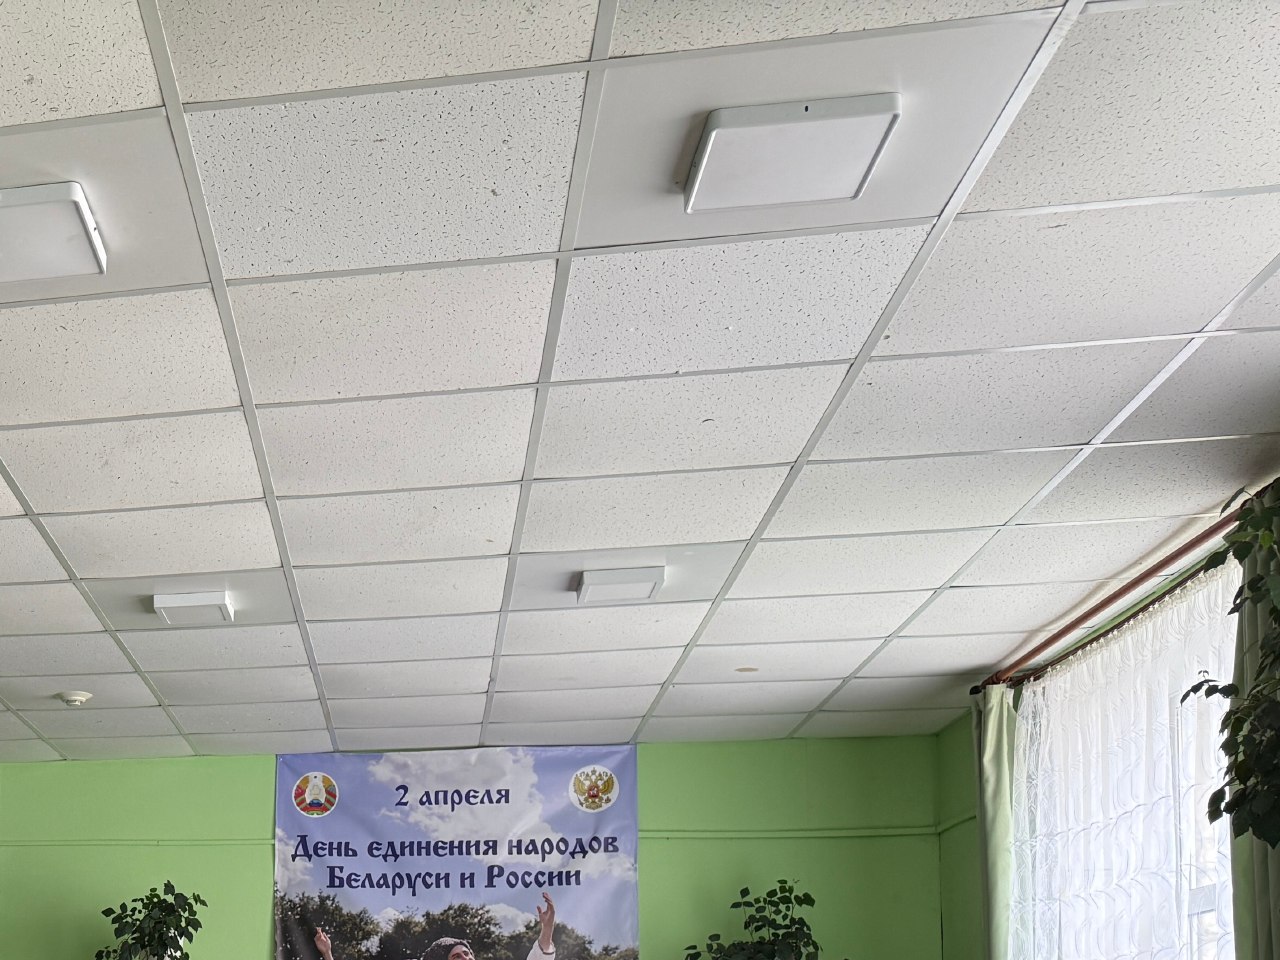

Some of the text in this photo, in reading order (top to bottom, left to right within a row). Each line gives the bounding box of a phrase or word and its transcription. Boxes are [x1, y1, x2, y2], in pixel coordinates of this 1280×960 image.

[395, 785, 511, 812] 2 апреля
[291, 835, 620, 862] День единения народов
[326, 864, 582, 896] Беларуси и России
